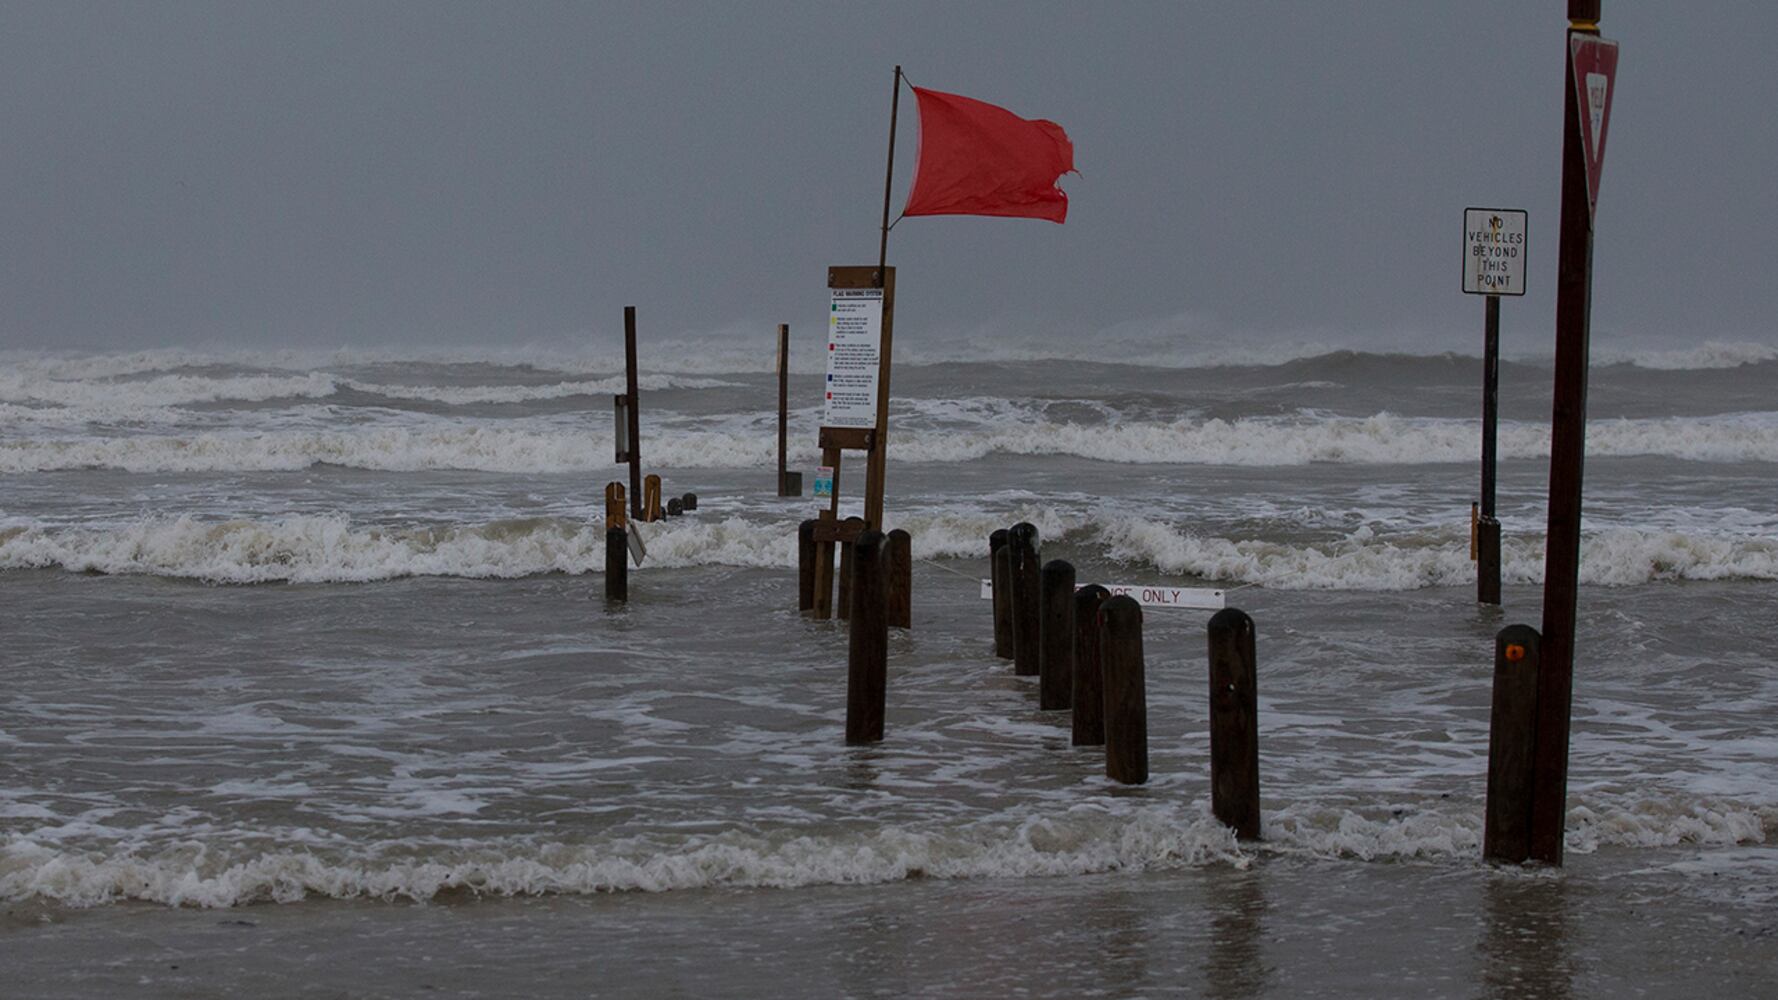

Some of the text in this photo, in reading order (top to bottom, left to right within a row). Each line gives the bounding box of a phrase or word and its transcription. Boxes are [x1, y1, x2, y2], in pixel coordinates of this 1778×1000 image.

[1489, 217, 1503, 229] NO
[1469, 231, 1523, 244] VEHICLES
[1473, 246, 1517, 258] BEYOND
[1482, 260, 1508, 272] THIS
[1477, 274, 1511, 287] POINT
[1142, 588, 1181, 604] ONLY
